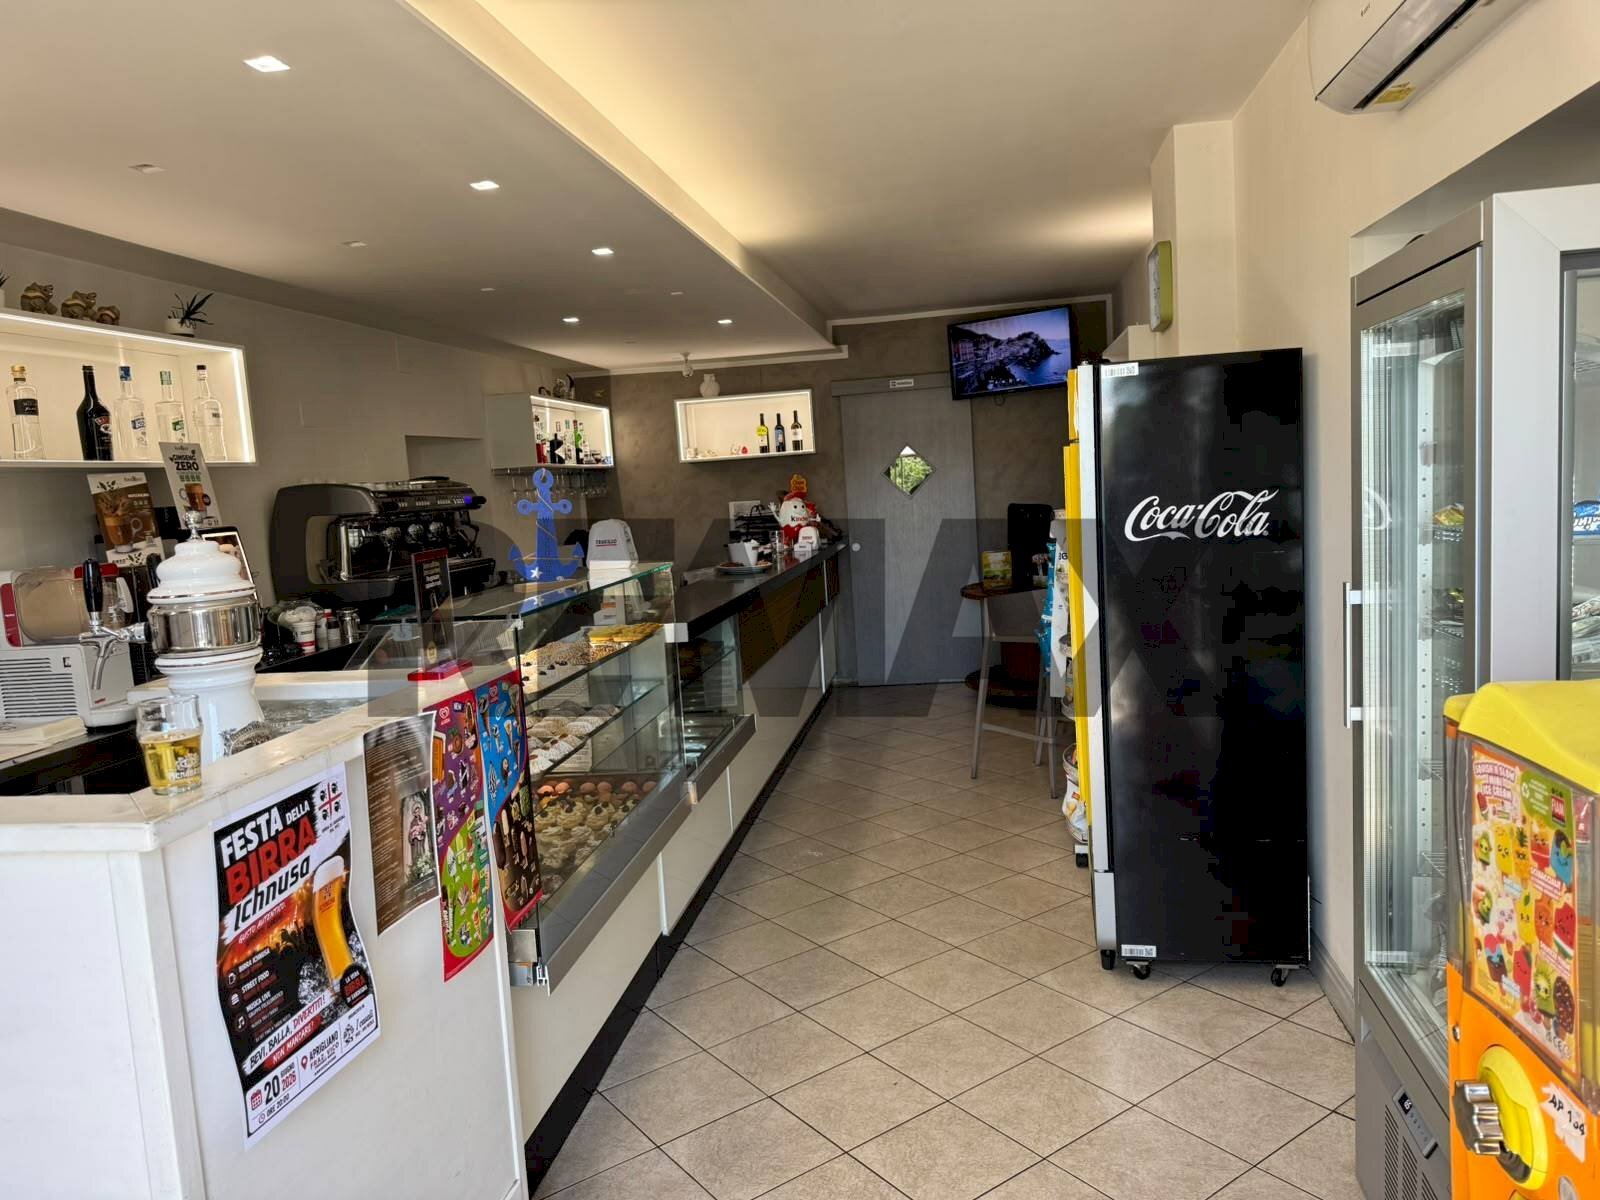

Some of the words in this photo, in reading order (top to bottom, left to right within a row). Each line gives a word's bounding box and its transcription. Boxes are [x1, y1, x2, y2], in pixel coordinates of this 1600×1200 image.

[174, 461, 200, 471] ZERO
[1124, 488, 1279, 542] Coca-Cola
[220, 806, 284, 868] FESTA
[286, 800, 310, 825] DELLA
[226, 816, 318, 905] BIRRA
[241, 978, 258, 994] STREET
[257, 969, 270, 982] FOOD
[249, 1046, 268, 1069] BEVI,
[268, 1027, 293, 1050] BALLA,
[272, 1046, 286, 1065] NON
[309, 1030, 339, 1062] APRIGLIANO
[263, 1075, 281, 1105] 20
[1549, 1093, 1564, 1112] AP
[266, 1104, 277, 1117] ORE
